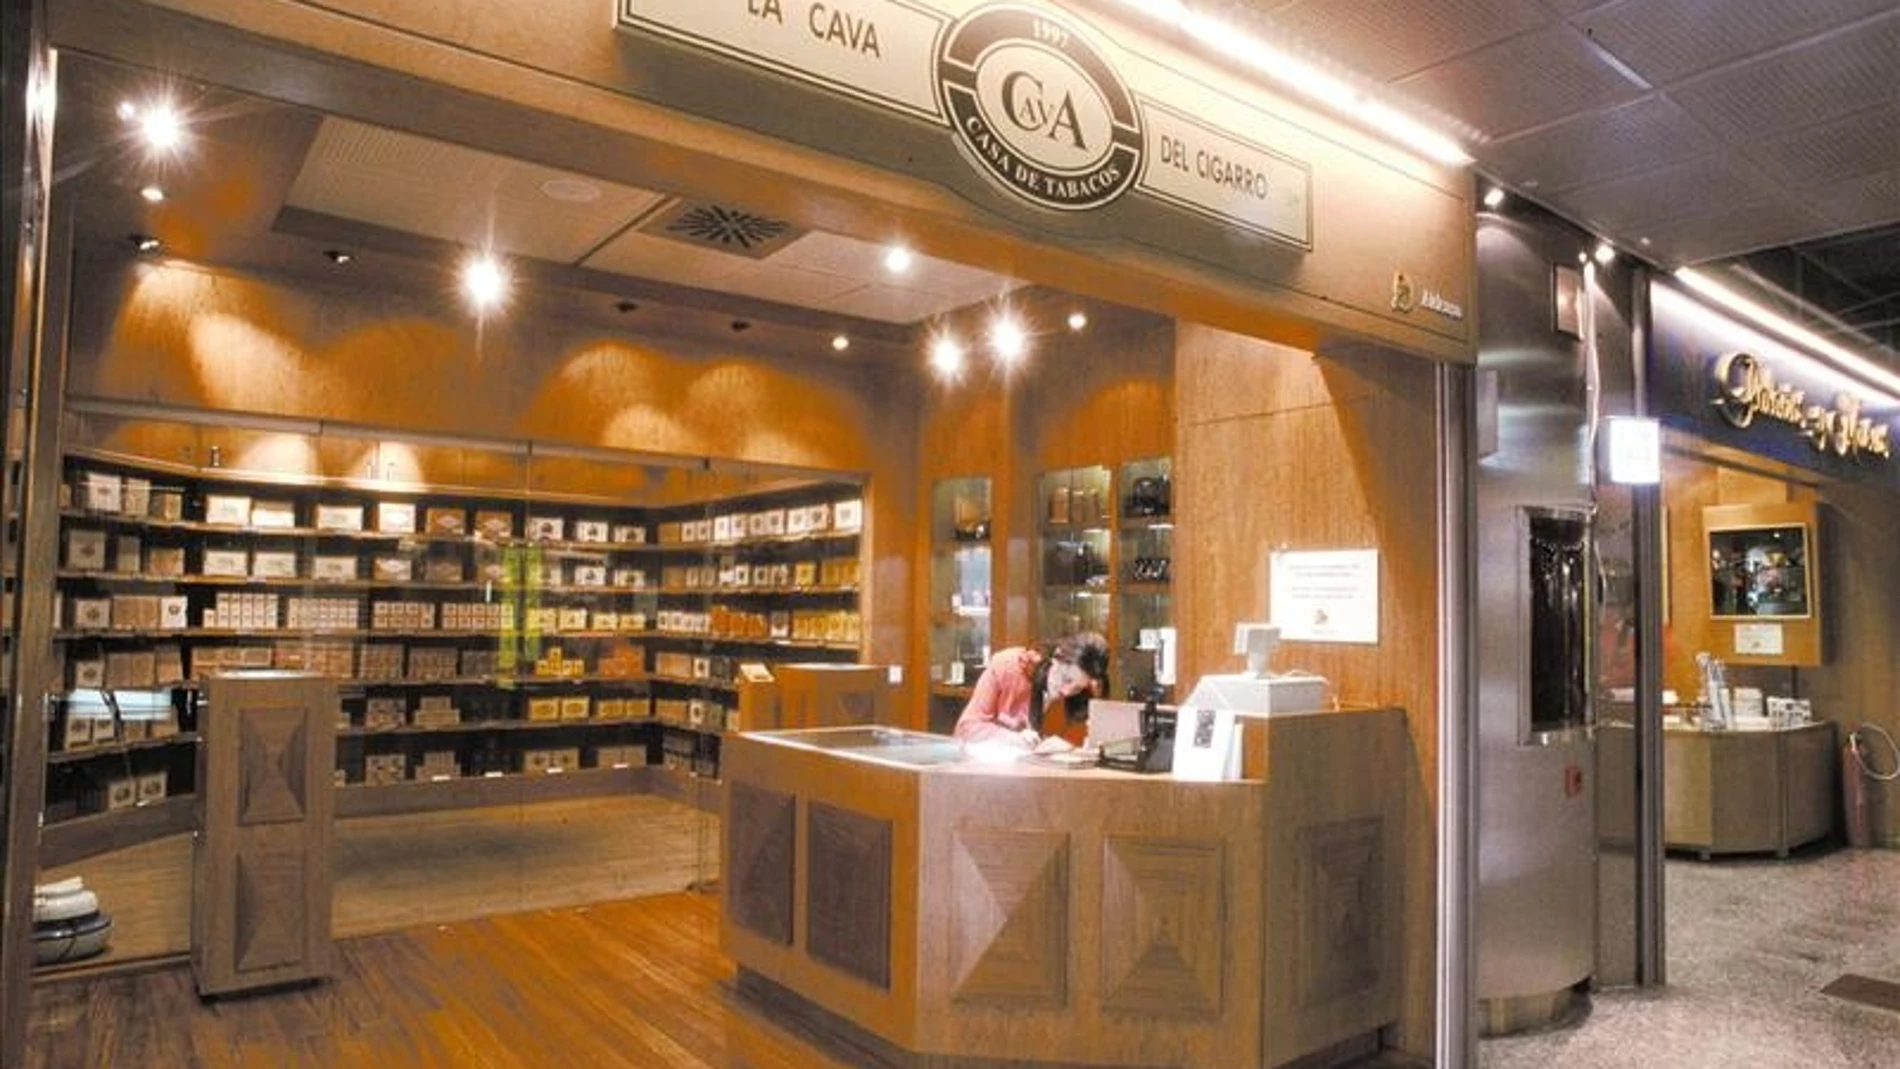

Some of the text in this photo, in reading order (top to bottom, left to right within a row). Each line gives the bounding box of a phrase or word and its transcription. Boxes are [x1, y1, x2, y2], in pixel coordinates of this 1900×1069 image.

[808, 2, 880, 58] CAVA
[966, 115, 1121, 198] CASA DE TABACOS
[1160, 135, 1269, 200] DEL CIGARRO
